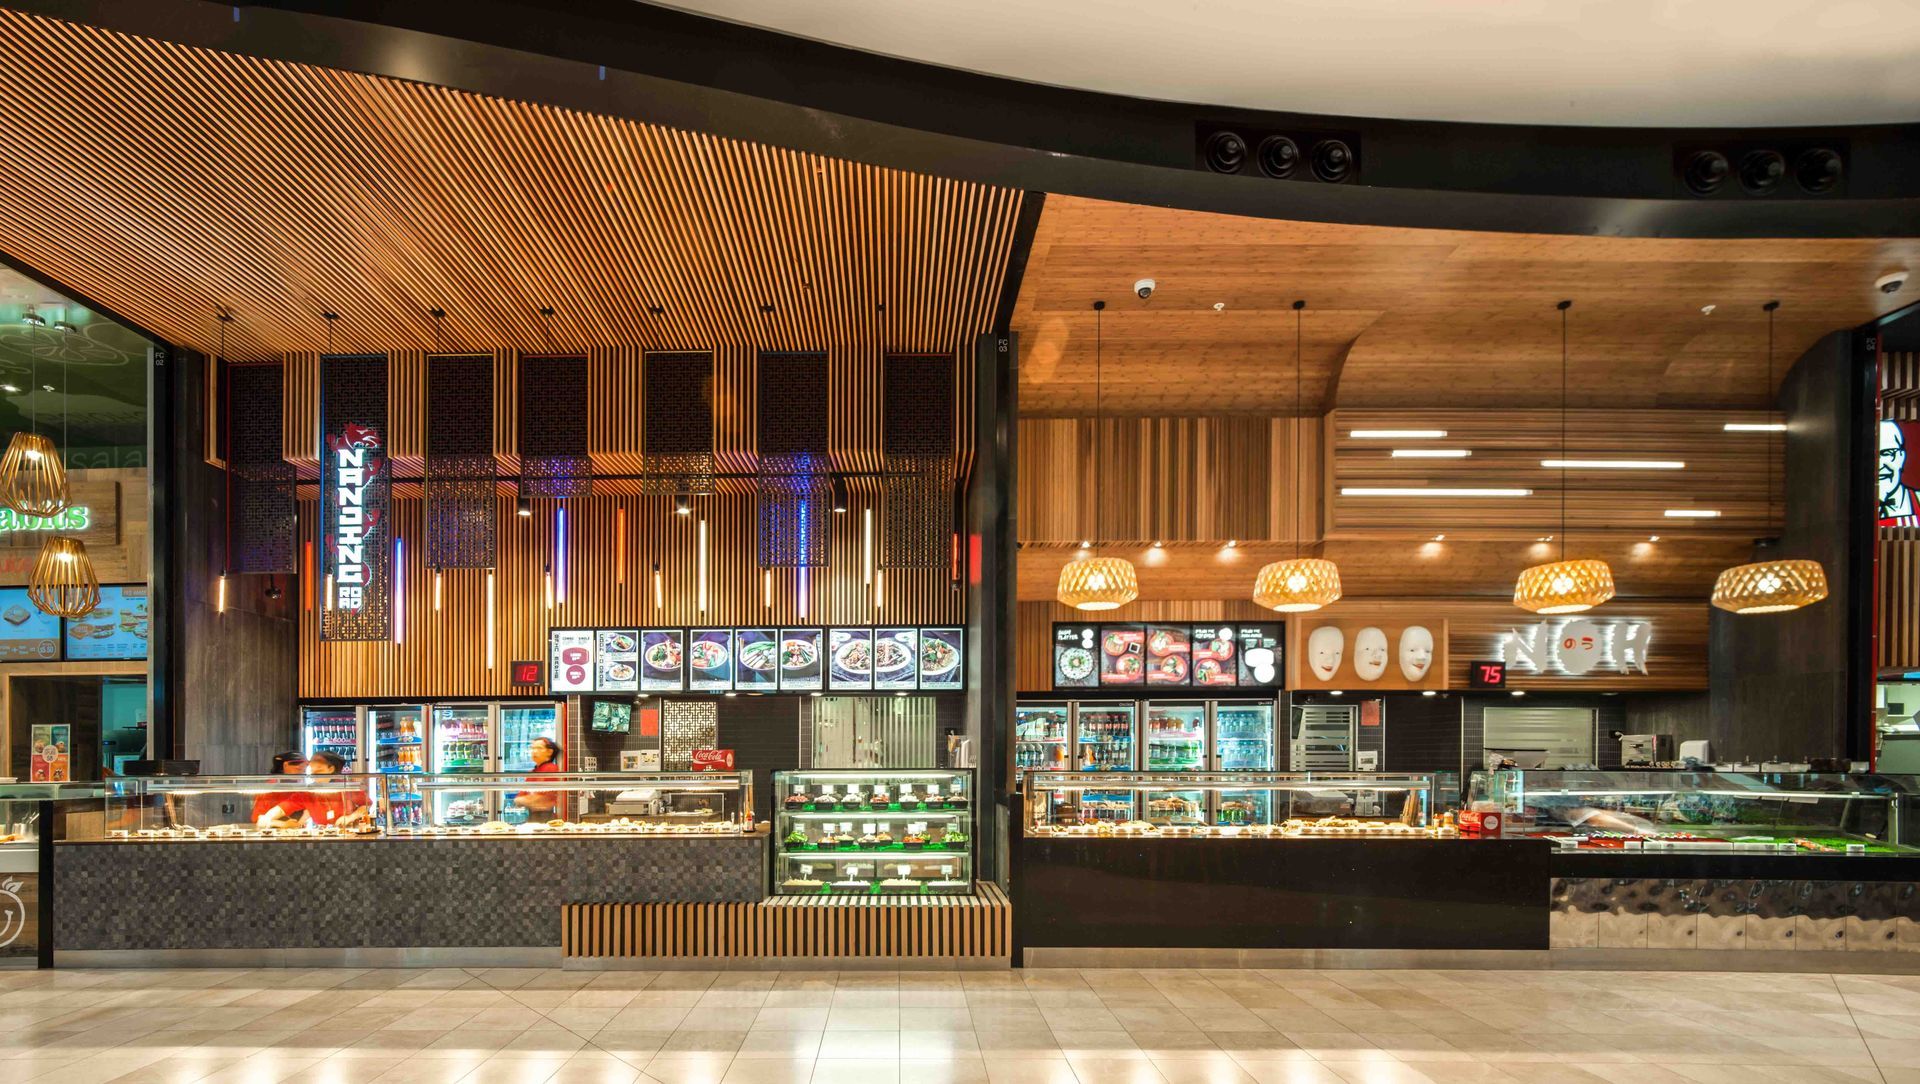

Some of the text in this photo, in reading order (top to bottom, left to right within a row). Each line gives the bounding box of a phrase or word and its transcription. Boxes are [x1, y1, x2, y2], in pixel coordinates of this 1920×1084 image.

[336, 448, 364, 583] NANJING
[1503, 618, 1652, 677] NOH
[522, 666, 537, 681] 12
[1480, 665, 1503, 684] 75
[695, 750, 722, 761] Coca-Cola
